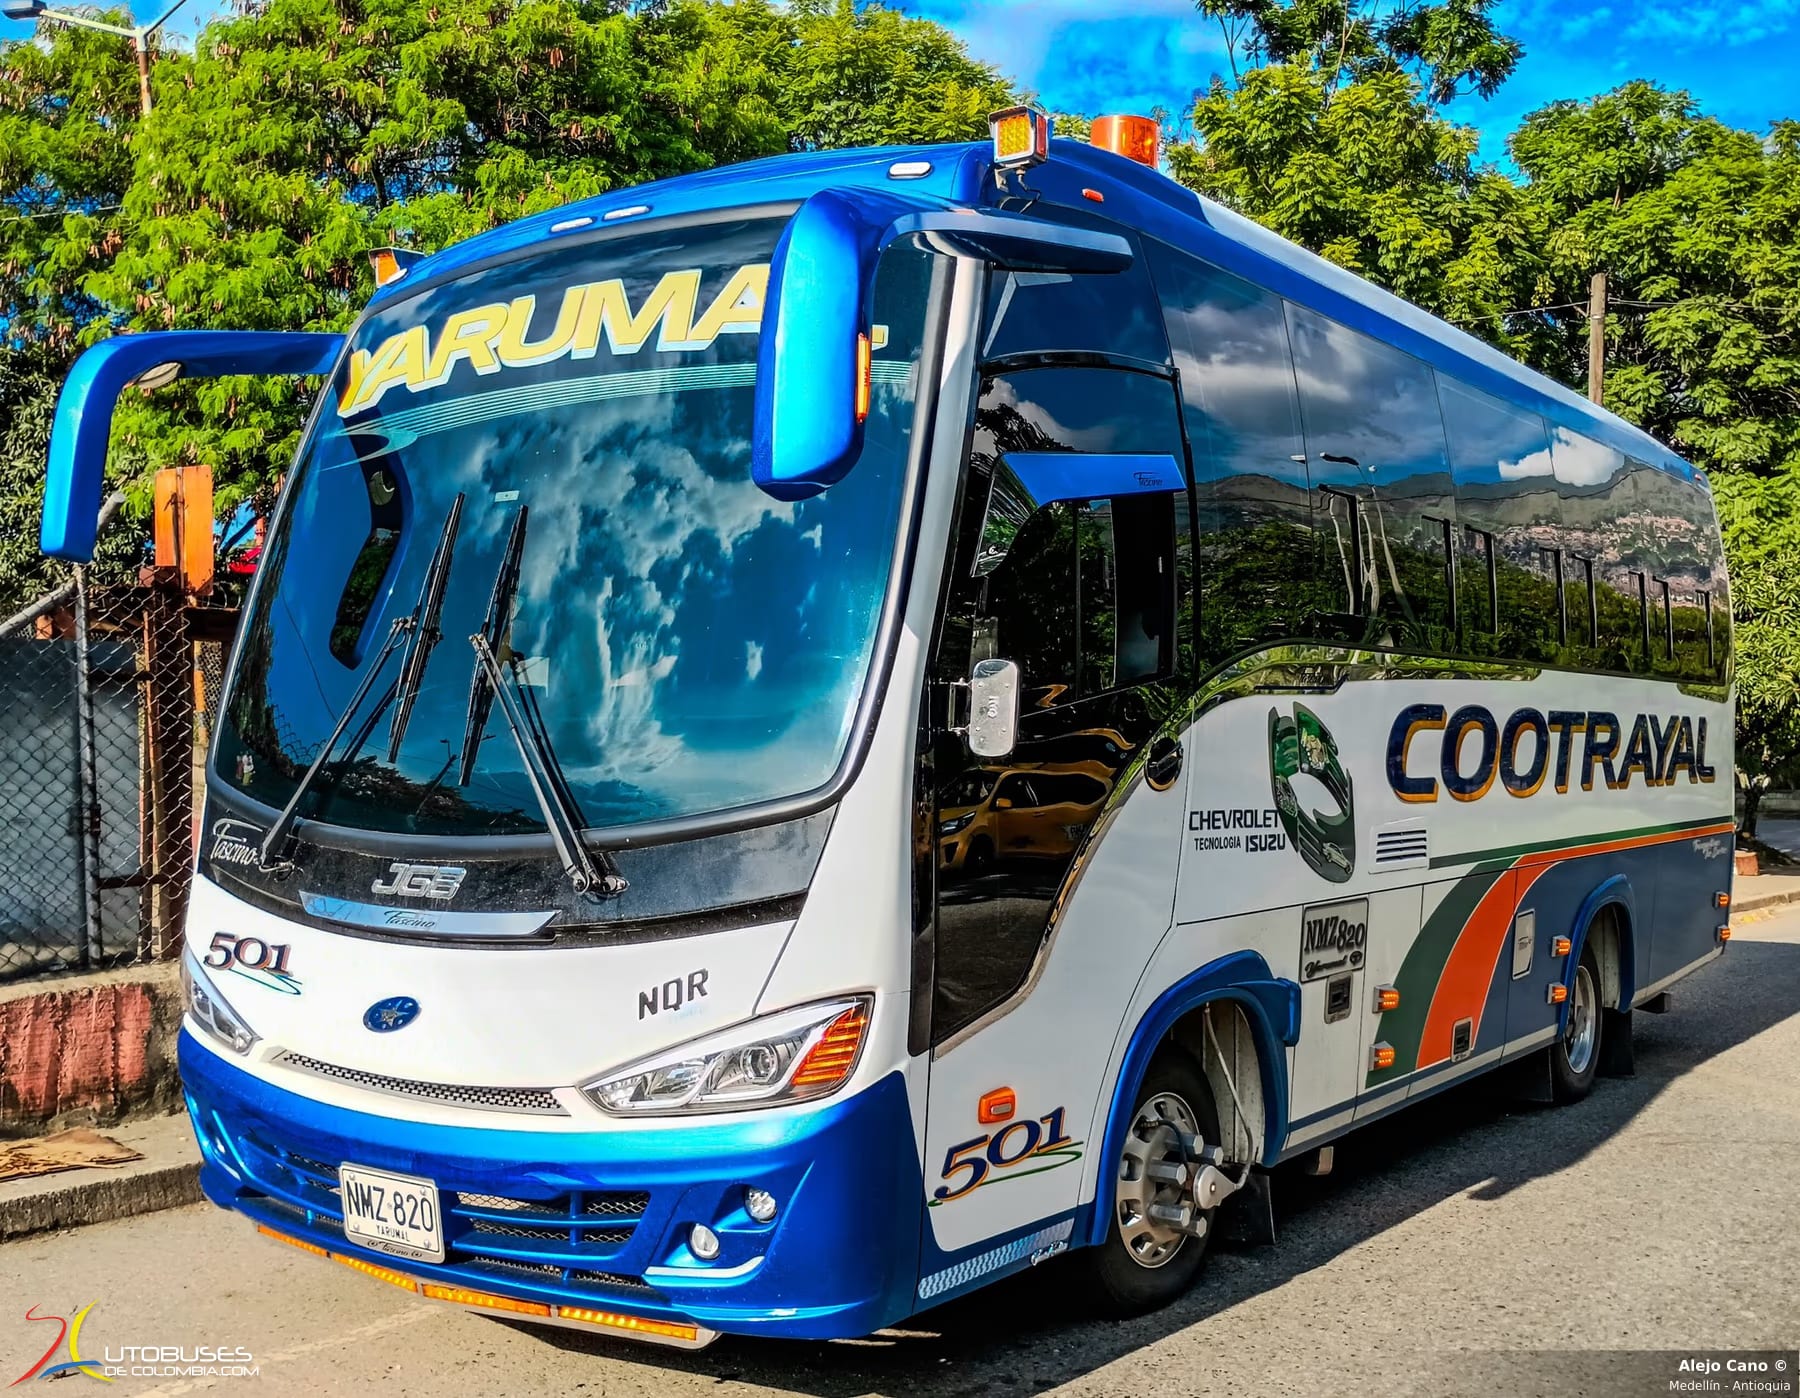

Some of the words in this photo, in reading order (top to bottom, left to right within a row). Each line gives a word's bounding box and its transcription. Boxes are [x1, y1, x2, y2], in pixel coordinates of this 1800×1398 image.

[337, 263, 889, 418] YARUMA
[1386, 703, 1715, 803] COOTRAYAL
[210, 818, 263, 866] Fascino
[1189, 809, 1279, 831] CHEVROLET
[1194, 836, 1241, 850] TECNOLOGIA
[1245, 833, 1286, 852] ISUZU
[203, 931, 294, 977] 501
[1304, 916, 1365, 954] NMZ820
[638, 968, 709, 1020] NQR
[933, 1106, 1073, 1203] 501
[346, 1180, 388, 1223] NMZ
[393, 1191, 434, 1232] 820
[376, 1224, 411, 1242] YARUMAL
